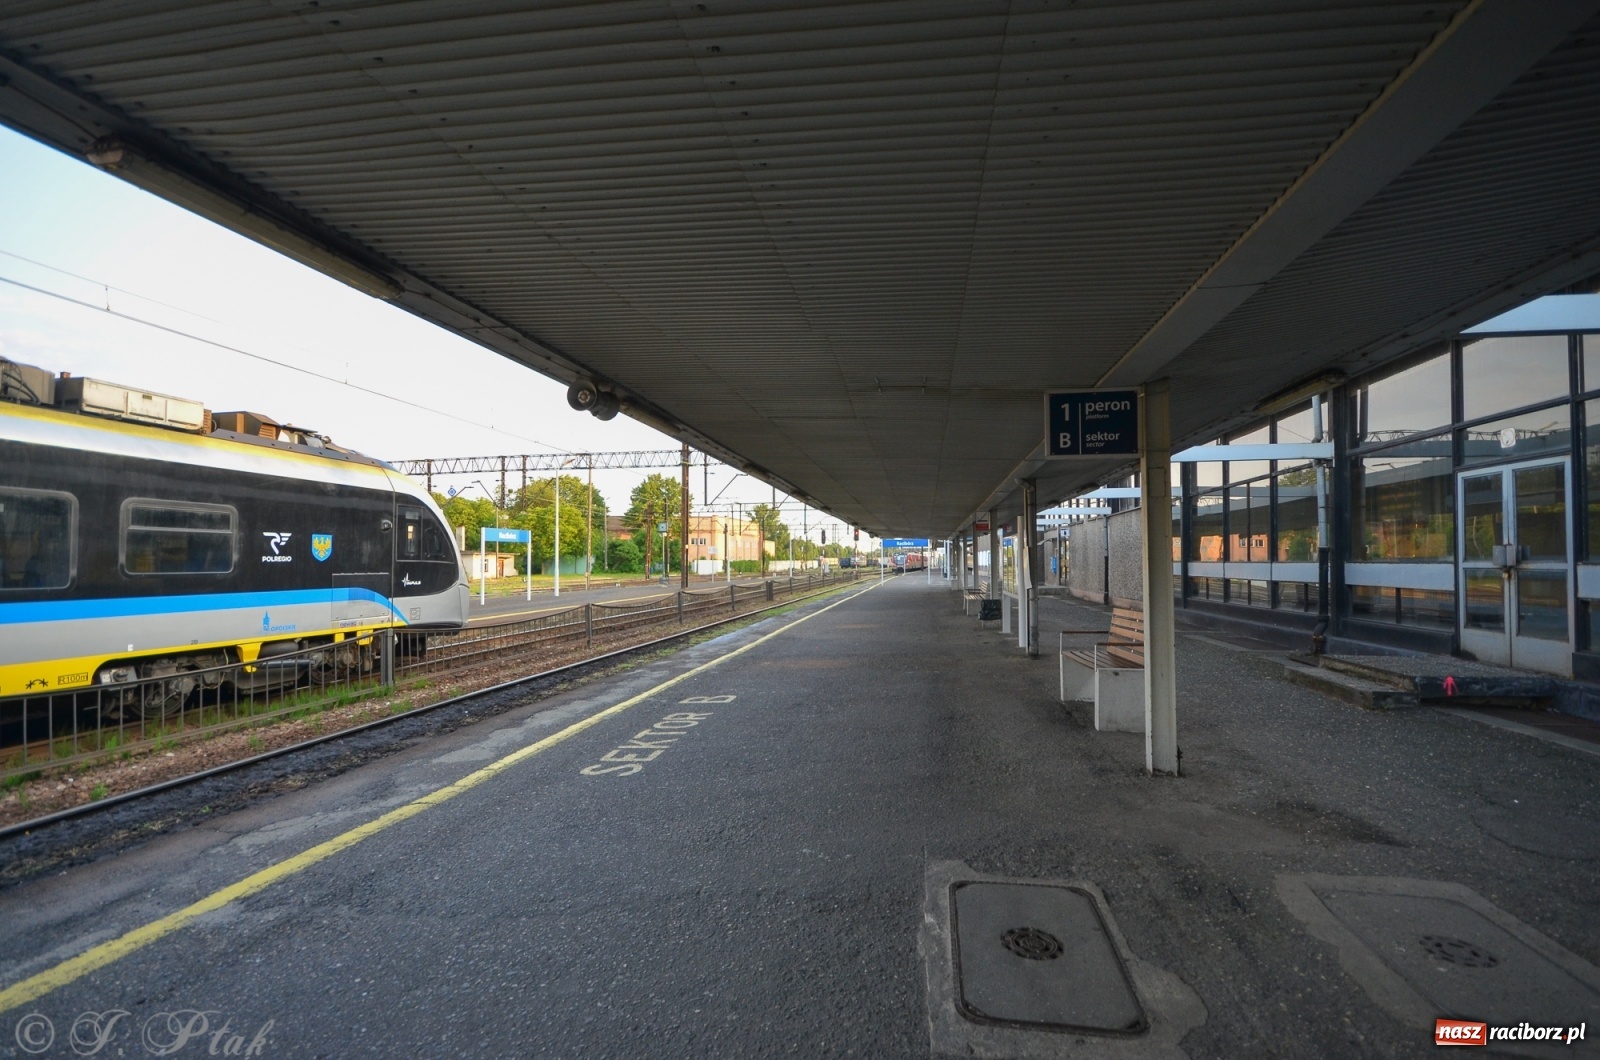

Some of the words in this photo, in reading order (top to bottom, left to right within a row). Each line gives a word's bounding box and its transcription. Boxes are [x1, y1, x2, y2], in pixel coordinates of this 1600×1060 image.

[1061, 403, 1070, 421] 1
[1085, 400, 1130, 415] peron
[1059, 432, 1071, 448] B
[1086, 431, 1120, 441] sektor
[579, 711, 714, 777] SEKTOR
[678, 694, 737, 704] B
